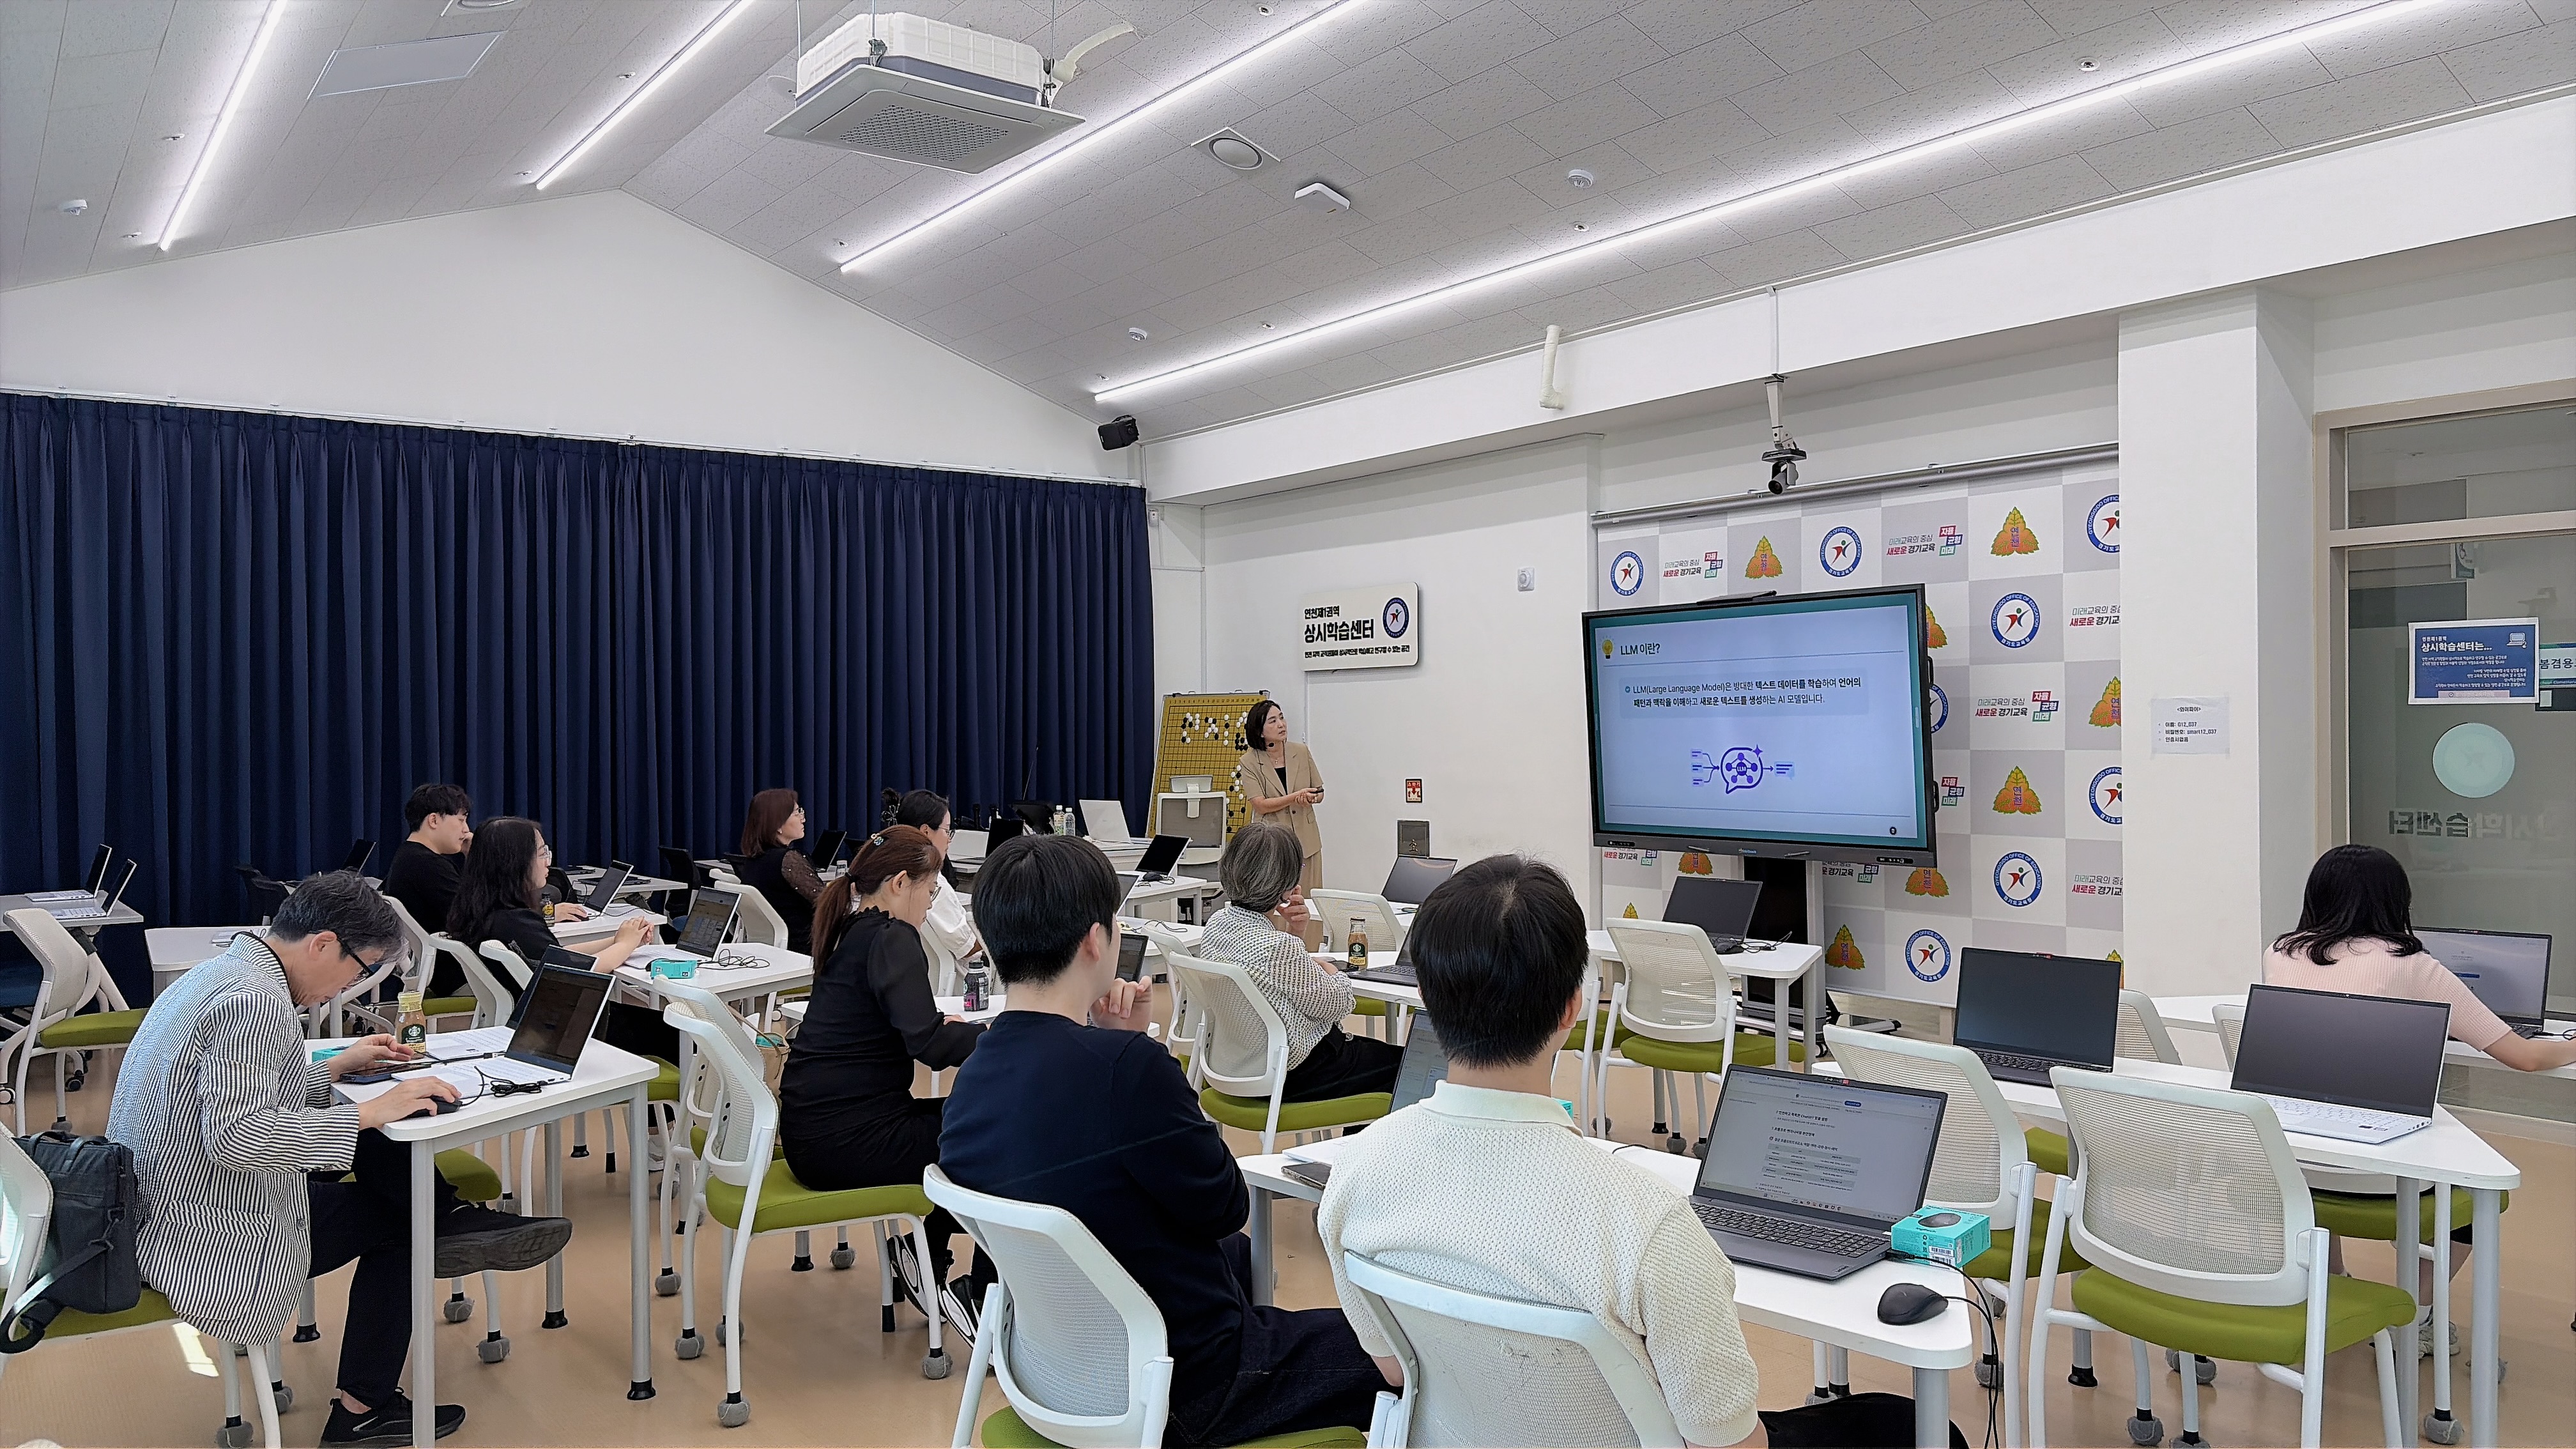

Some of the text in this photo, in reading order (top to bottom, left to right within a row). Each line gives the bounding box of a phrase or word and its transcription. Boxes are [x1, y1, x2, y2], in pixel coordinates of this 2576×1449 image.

[1940, 526, 1955, 535] 자율
[1889, 534, 1933, 546] 미래교육의 중심
[1947, 535, 1961, 544] 균형
[1887, 544, 1935, 555] 새로운 경기교육
[1941, 546, 1954, 555] 미래
[2098, 542, 2119, 551] 경기도교
[1664, 560, 1688, 569] 미래교육의
[1663, 567, 1701, 578] 새로운 경기교육
[2072, 606, 2108, 616] 미래교육의
[2069, 615, 2120, 626] 새로운 경기교
[1305, 619, 1374, 643] 상시학습센터
[1620, 643, 1660, 656] LLM 이란?
[2421, 641, 2492, 652] 상시학습센터는...
[2539, 658, 2576, 670] 봄겸용
[1633, 677, 1861, 695] LLM(Large Language Model)은 방대한 텍스트 데이터를 학습하여 언어의
[1634, 694, 1825, 708] 패턴과 맥락을 이해하고 새로운 텍스트를 생성하는 AI 모델입니다.
[2033, 692, 2050, 701] 자율
[1977, 698, 2025, 707] 미래교육의 중심
[2041, 702, 2058, 710] 균형
[1975, 707, 2028, 717] 새로운 경기교육
[2034, 712, 2050, 721] 미래
[1943, 778, 1957, 786] 자율
[1949, 787, 1964, 796] 균형
[2100, 813, 2121, 823] 경기도교
[1618, 852, 1638, 861] 경기교육
[1828, 868, 1854, 877] 경기교육
[1864, 865, 1878, 875] 균형
[1859, 875, 1873, 883] 미래
[2074, 874, 2110, 884] 미래교육의
[2072, 884, 2123, 896] 새로운 경기교
